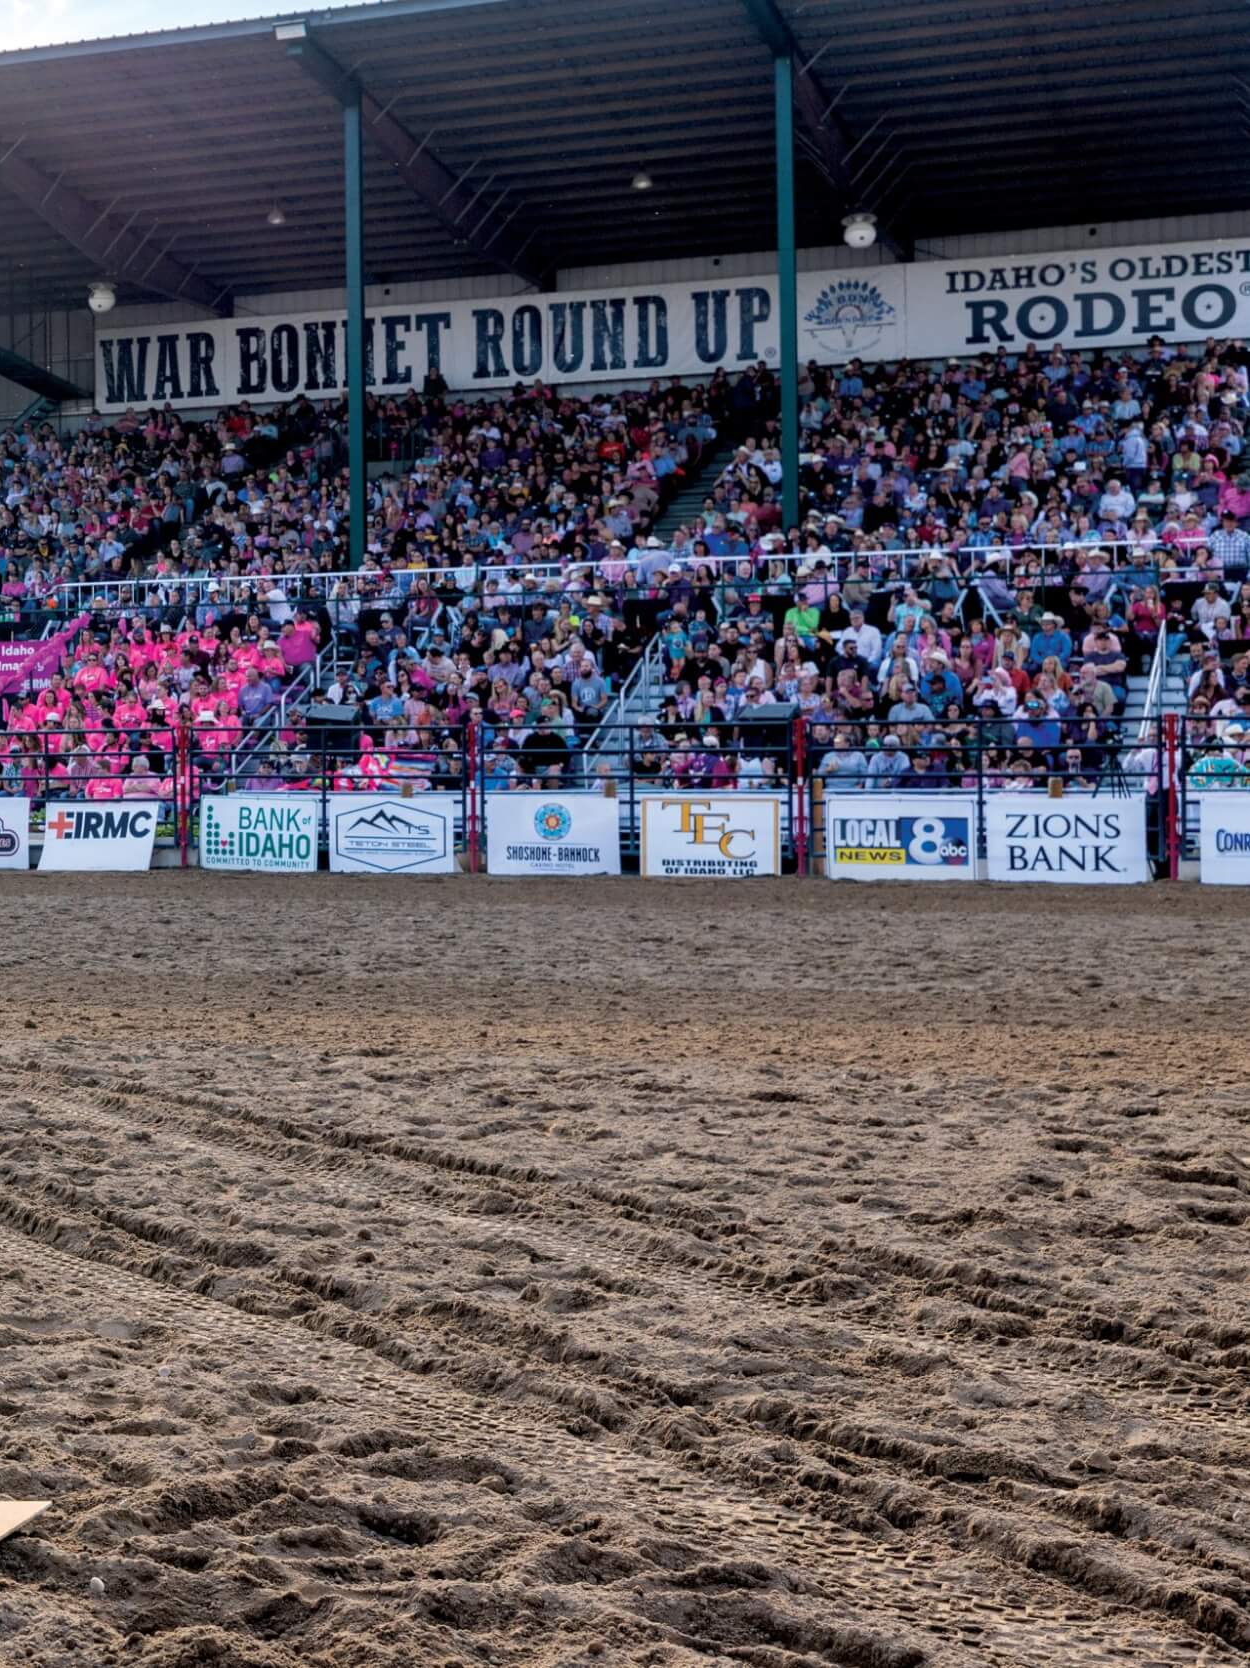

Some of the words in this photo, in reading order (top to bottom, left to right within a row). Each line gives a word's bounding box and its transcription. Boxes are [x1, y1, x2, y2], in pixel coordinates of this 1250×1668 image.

[946, 260, 1096, 293] IDAHO'S
[1108, 250, 1250, 282] OLDEST
[965, 283, 1237, 345] RODEO
[100, 332, 220, 403] WAR
[472, 295, 669, 379] ROUND
[691, 287, 771, 363] UP
[1, 644, 35, 656] Idaho
[239, 807, 300, 832] BANK
[302, 816, 311, 824] of
[662, 800, 756, 859] TEC
[1006, 813, 1121, 839] ZIONS
[239, 832, 310, 860] IDAHO
[349, 840, 389, 848] TETON
[834, 820, 901, 848] LOCAL
[909, 817, 945, 864] 8
[206, 857, 249, 866] COMMITTED
[252, 859, 261, 867] TO
[264, 859, 310, 868] COMMUNITY
[839, 851, 903, 861] NEWS
[940, 842, 967, 857] abc
[1007, 845, 1122, 873] BANK
[661, 859, 758, 868] DISTRIBUTING
[665, 867, 681, 875] OF
